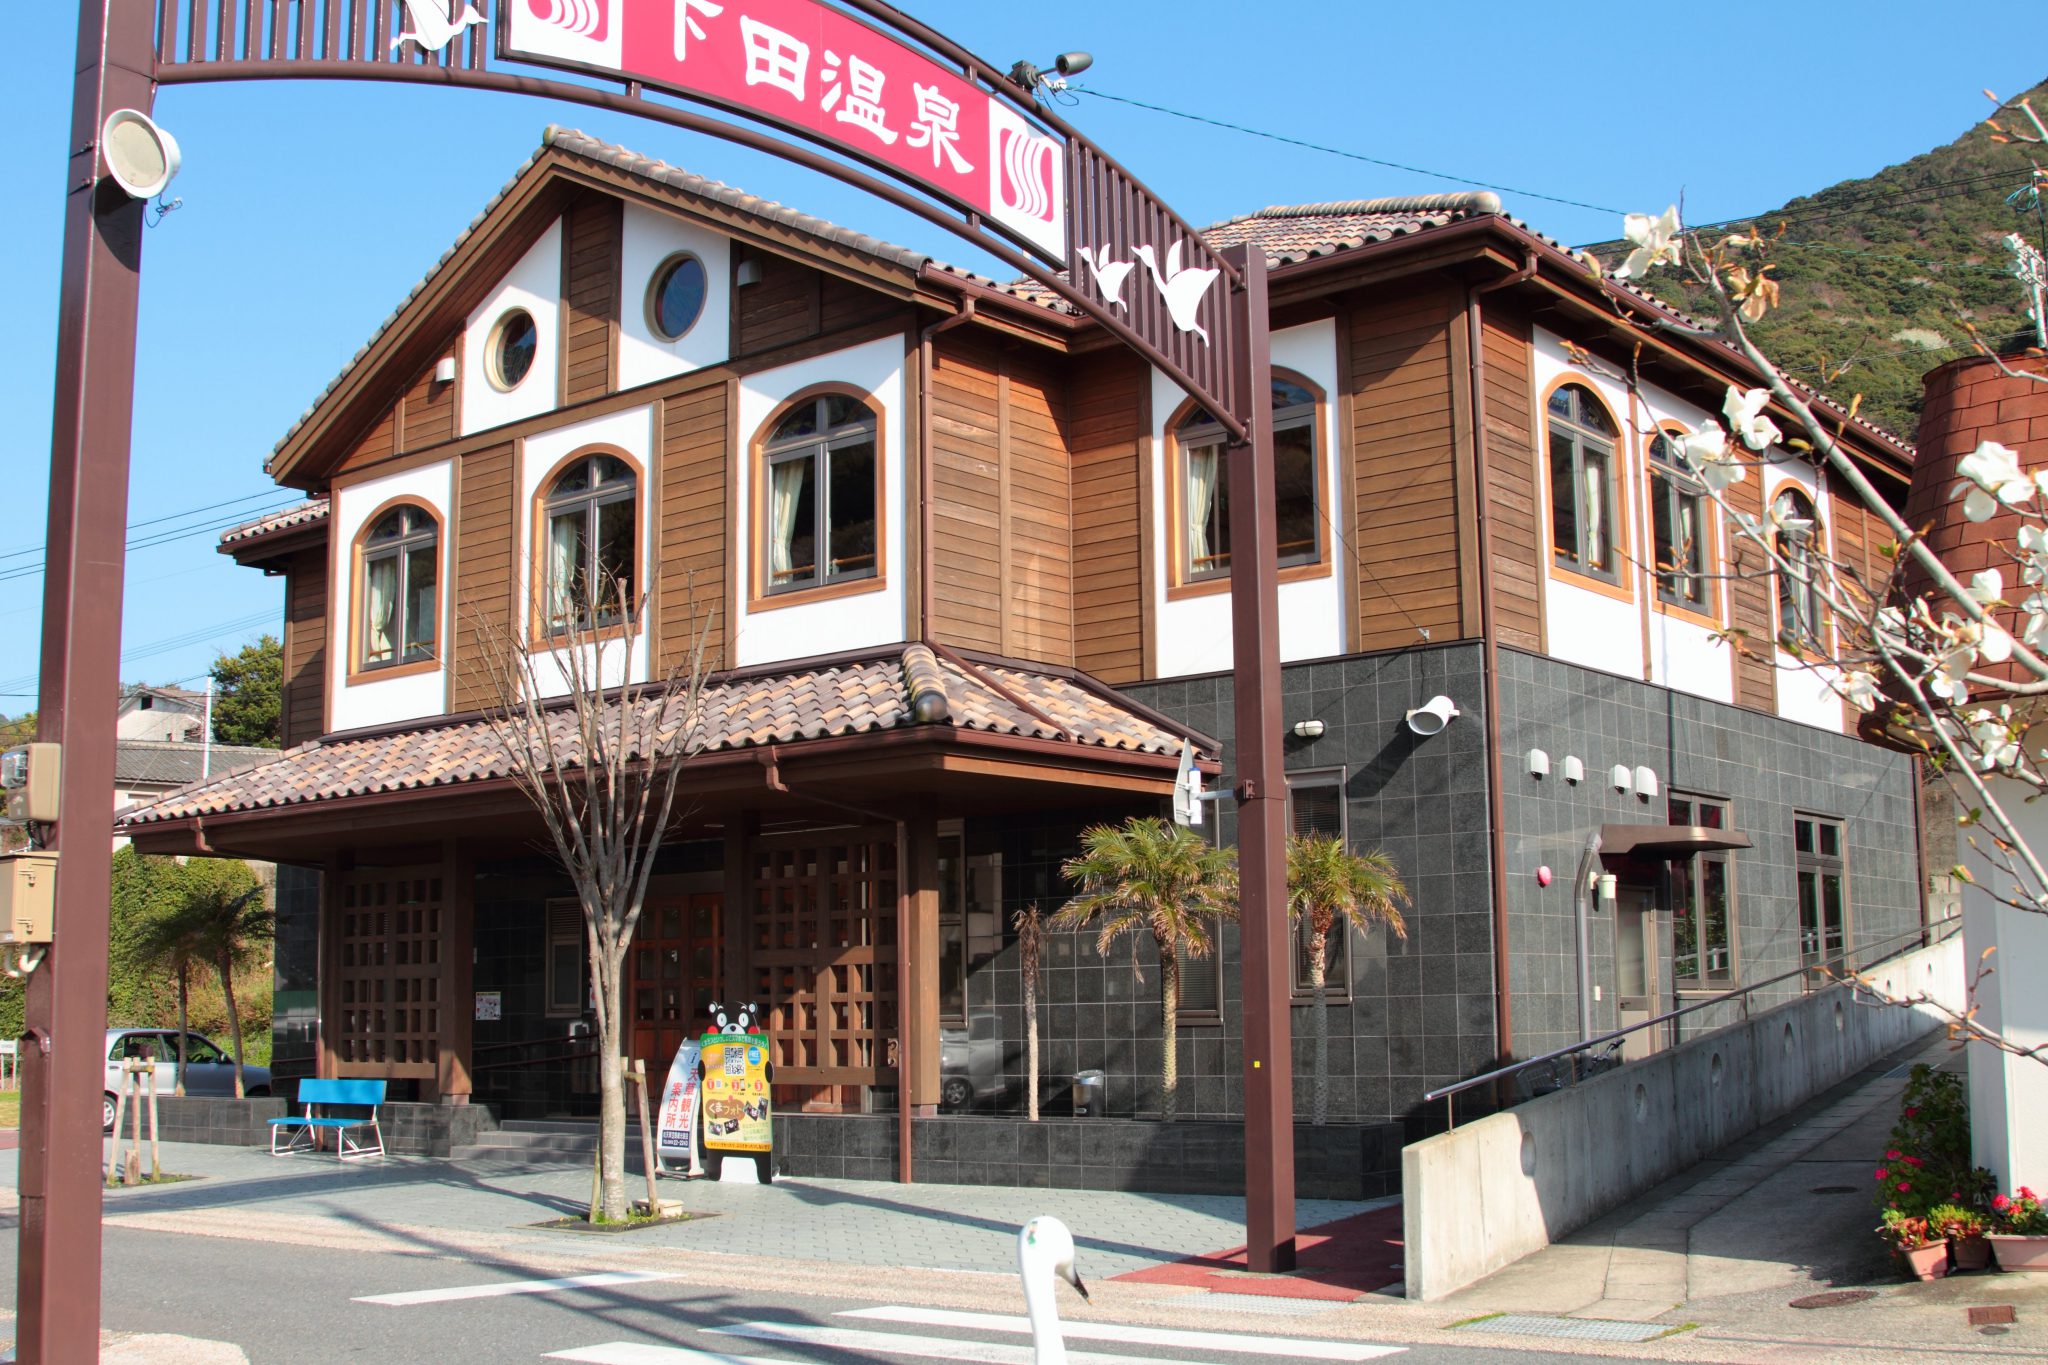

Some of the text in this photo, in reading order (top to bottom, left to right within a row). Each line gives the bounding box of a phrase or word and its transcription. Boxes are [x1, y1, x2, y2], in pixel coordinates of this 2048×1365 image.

[673, 0, 975, 174] 下田温泉
[665, 1082, 682, 1129] 案内所
[679, 1068, 698, 1129] 天草観光
[708, 1102, 742, 1115] くまフォト
